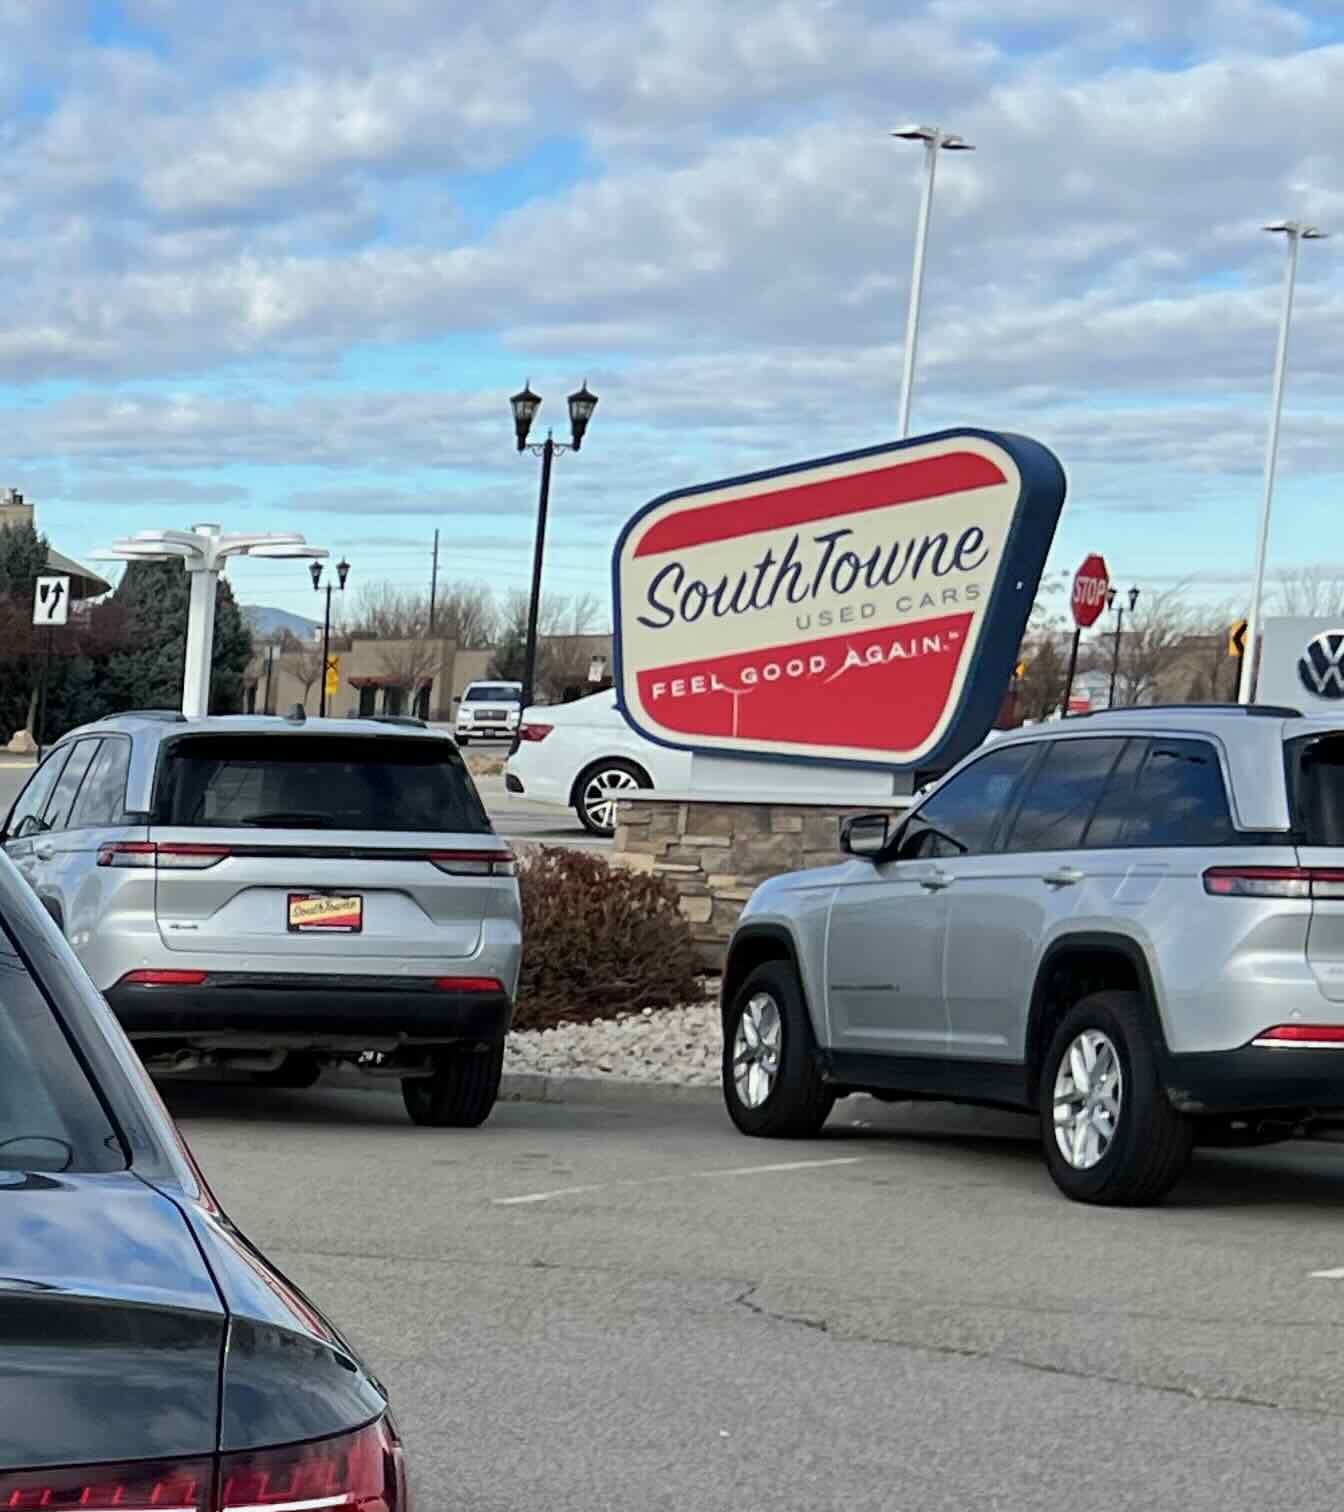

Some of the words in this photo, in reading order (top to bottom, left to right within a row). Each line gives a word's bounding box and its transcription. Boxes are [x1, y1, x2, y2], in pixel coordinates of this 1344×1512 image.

[637, 527, 988, 628] SouthTowne
[1073, 576, 1106, 606] STOP
[796, 603, 875, 630] USED
[896, 584, 982, 613] CARS
[652, 674, 723, 699] FEEL
[741, 655, 826, 684] GOOD
